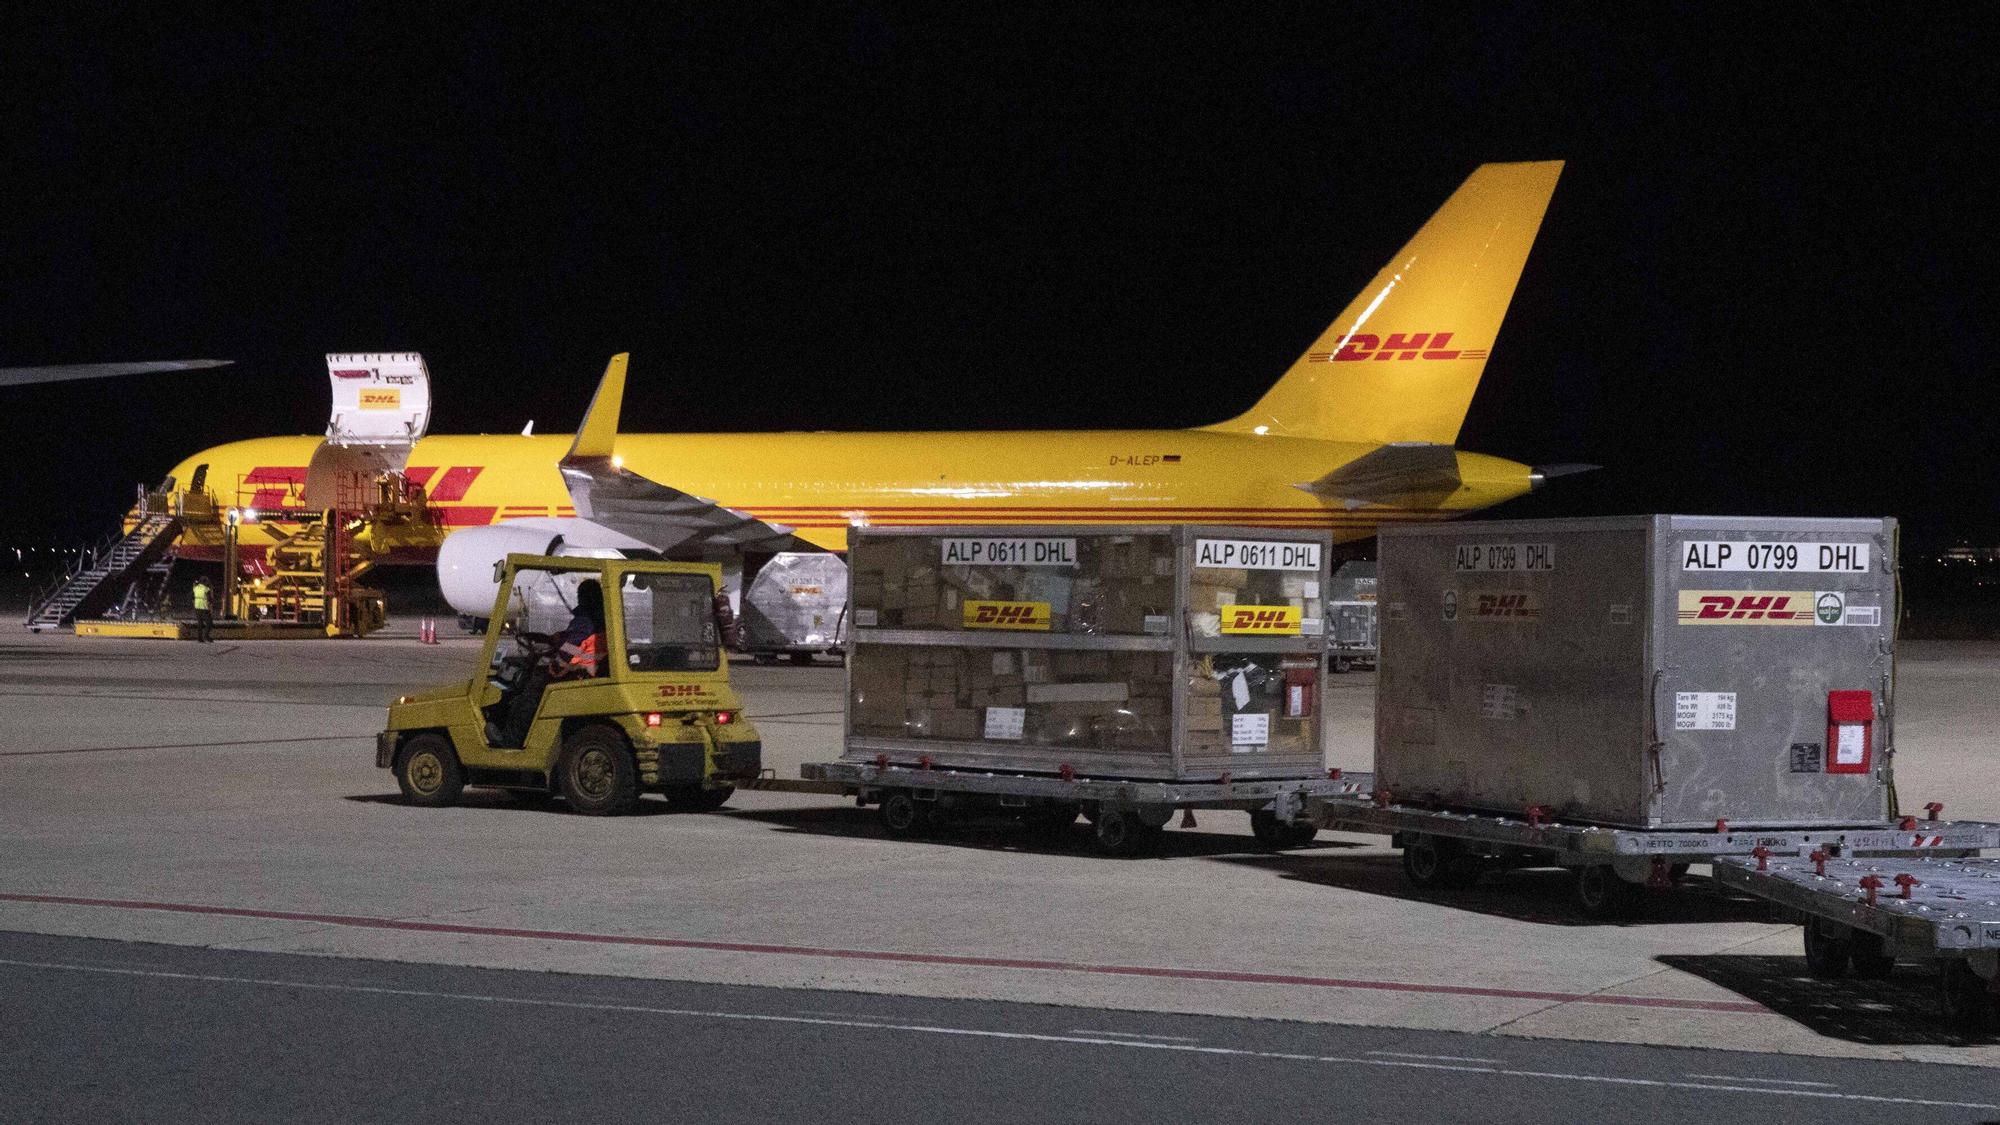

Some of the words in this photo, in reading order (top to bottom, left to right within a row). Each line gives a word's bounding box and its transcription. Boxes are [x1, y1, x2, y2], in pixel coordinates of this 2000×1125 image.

[1331, 333, 1461, 361] DHL
[1109, 455, 1160, 466] D-ALEP
[946, 542, 982, 562] ALP
[988, 542, 1027, 562] 0611
[1035, 542, 1072, 562] DHL
[1200, 544, 1235, 565] ALP
[1240, 545, 1276, 566] 0611
[1283, 546, 1316, 567] DHL
[1456, 546, 1481, 570] ALP
[1488, 546, 1516, 569] 0799
[1526, 546, 1552, 569] DHL
[1685, 544, 1732, 569] ALP
[1748, 544, 1798, 569] 0799
[1819, 546, 1864, 570] DHL
[976, 605, 1038, 625] DHL
[1478, 595, 1529, 616] DHL
[1697, 596, 1796, 619] DHL
[1233, 611, 1290, 629] DHL
[658, 685, 707, 697] DHL
[1647, 840, 1673, 848] NETTO
